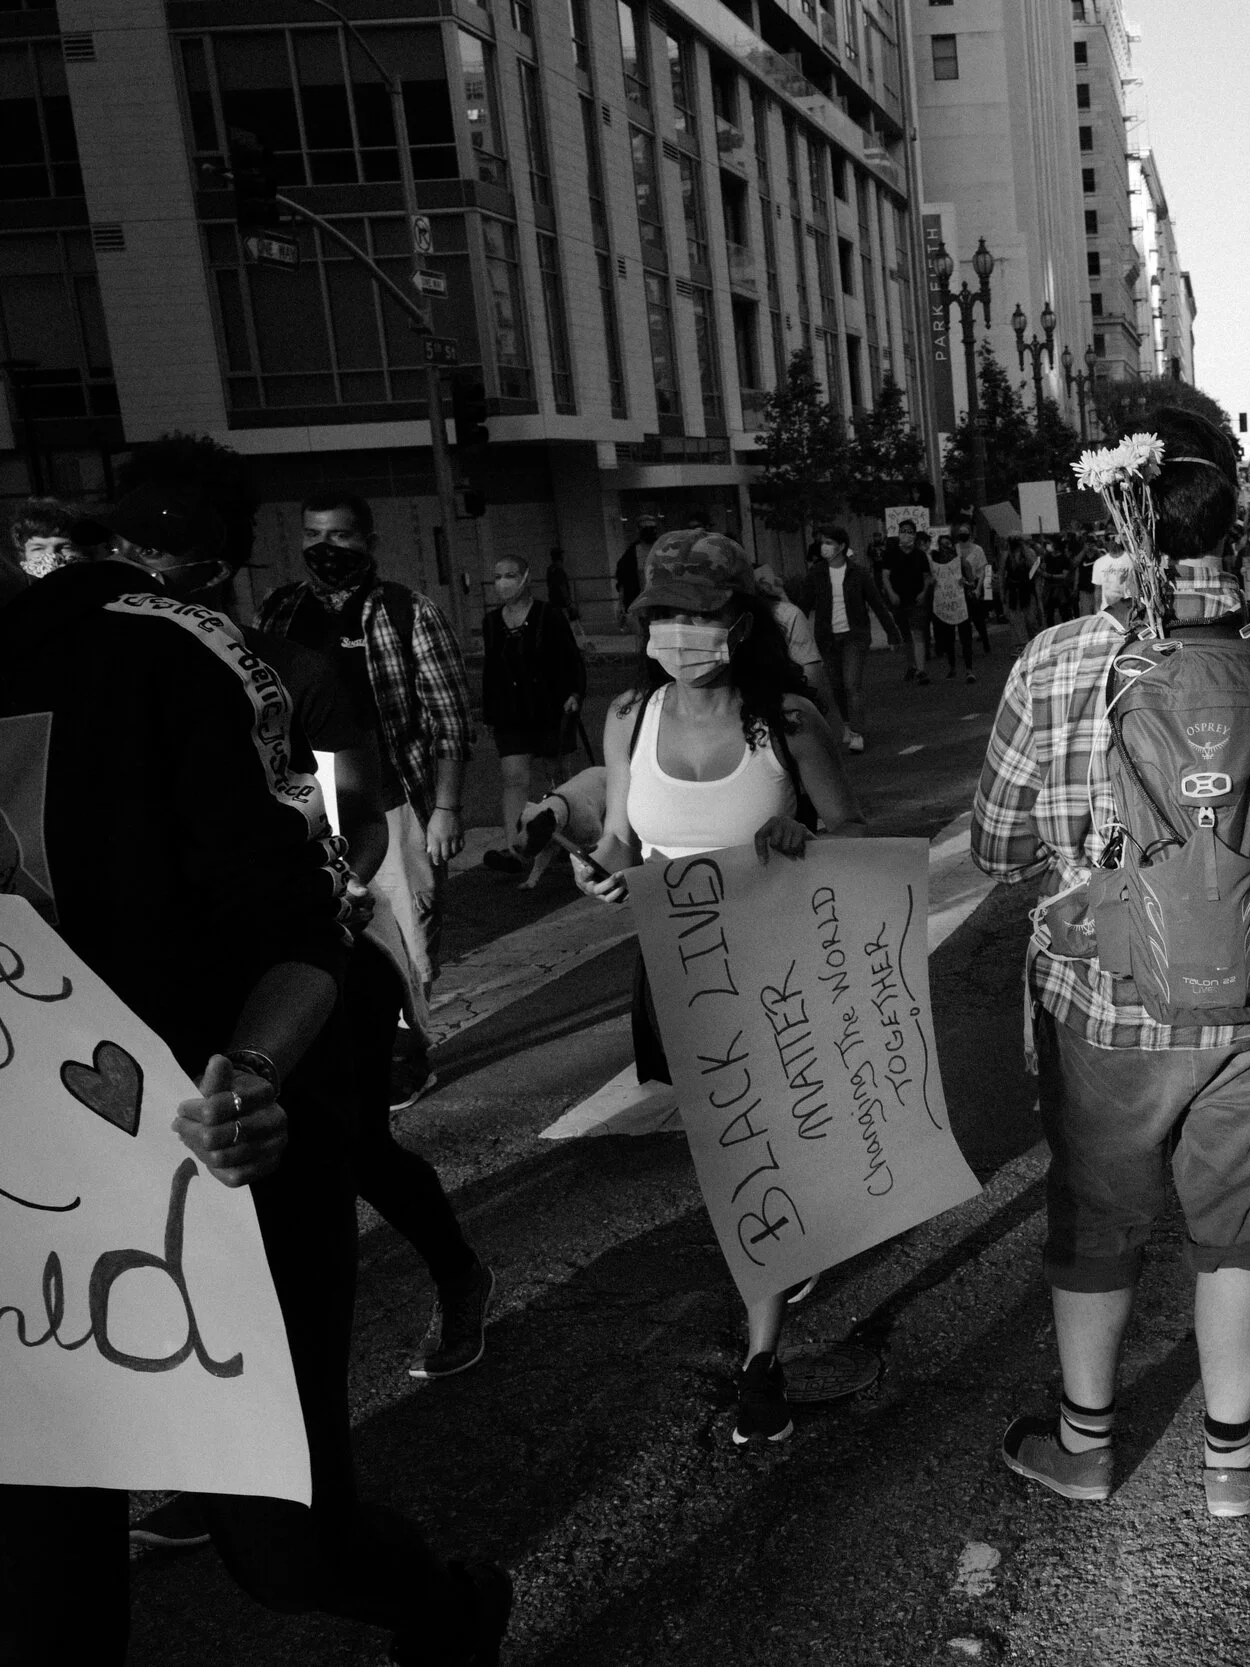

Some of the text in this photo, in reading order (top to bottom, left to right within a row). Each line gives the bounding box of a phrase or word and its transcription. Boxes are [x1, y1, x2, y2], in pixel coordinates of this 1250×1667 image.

[257, 239, 297, 262] ONE WAY
[931, 304, 948, 362] PARK
[1185, 720, 1231, 737] OSPREY
[812, 886, 850, 1005] WORLD
[664, 857, 805, 1266] BLACK LIVES
[760, 959, 833, 1140] MATTER
[864, 922, 912, 1106] TOGETHER
[849, 1060, 894, 1197] Changing
